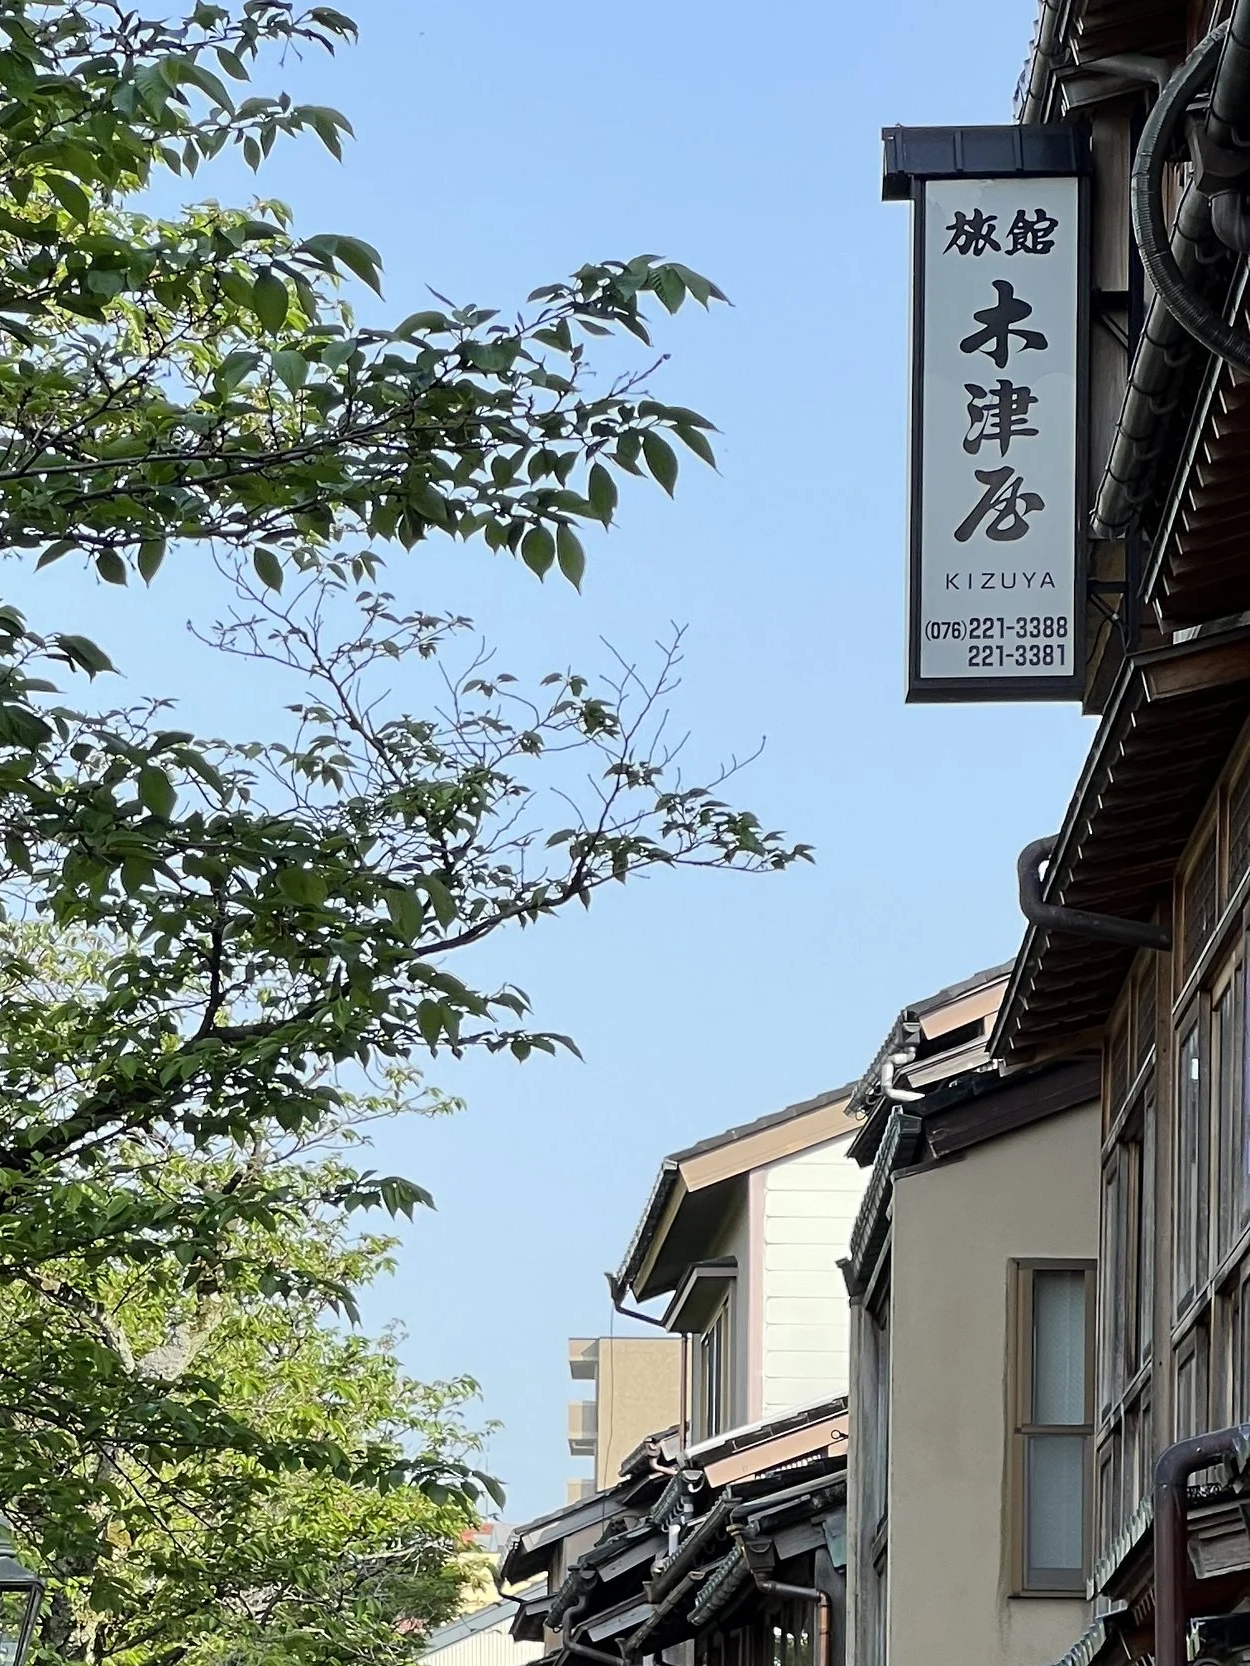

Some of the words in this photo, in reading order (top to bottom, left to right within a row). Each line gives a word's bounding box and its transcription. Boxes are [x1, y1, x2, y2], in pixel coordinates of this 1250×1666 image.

[942, 207, 1059, 257] 旅館
[953, 279, 1049, 543] 木津屋
[945, 571, 1056, 591] KIZUYA
[968, 644, 1066, 667] 221-3381
